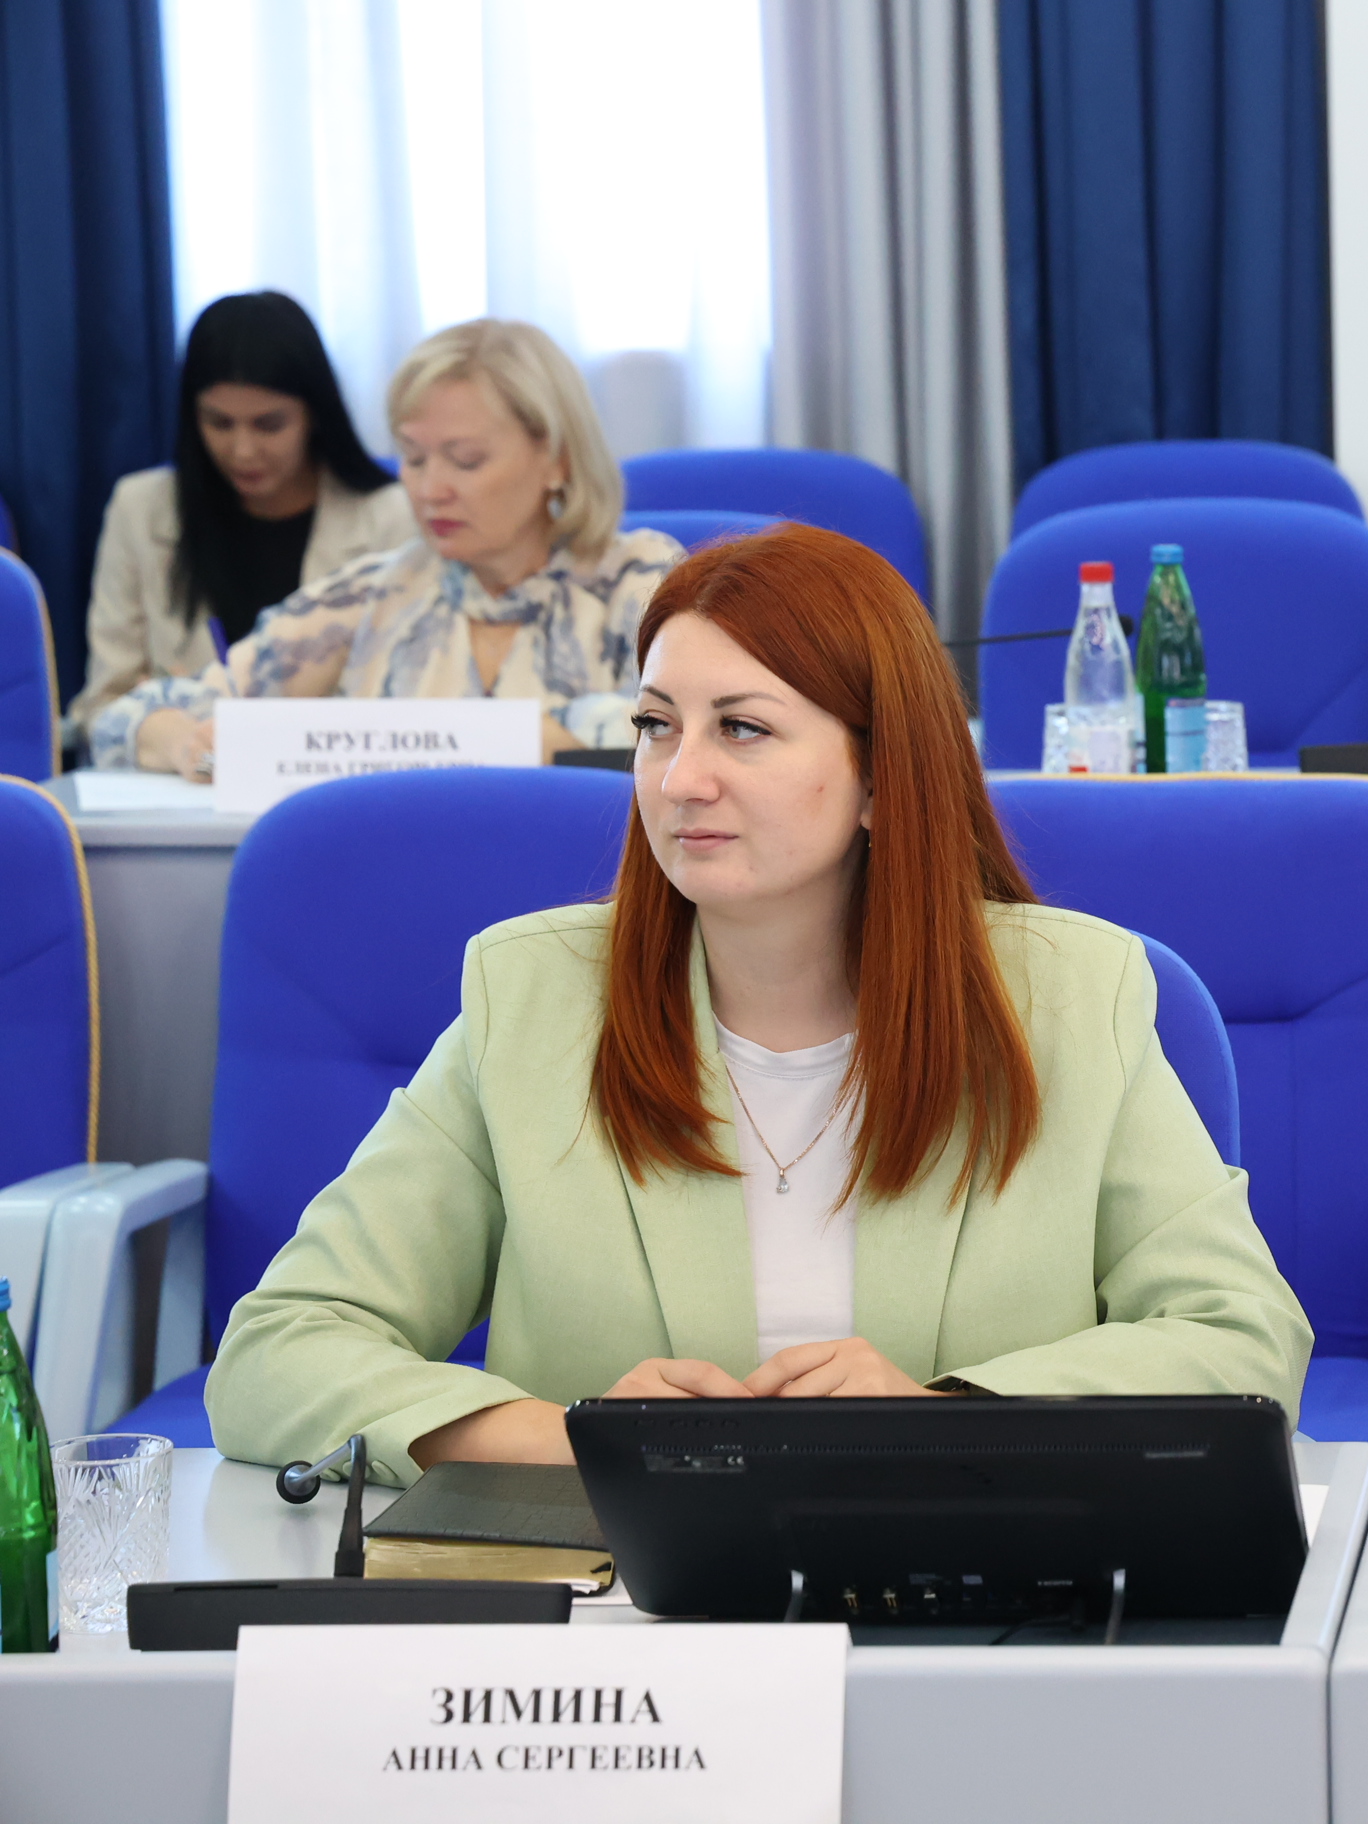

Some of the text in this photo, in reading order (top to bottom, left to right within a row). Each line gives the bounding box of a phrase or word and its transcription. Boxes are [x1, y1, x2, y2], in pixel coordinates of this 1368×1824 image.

[304, 730, 459, 752] КРУГЛОВА
[429, 1686, 663, 1725] ЗИМИНА
[383, 1745, 707, 1772] АННА СЕРГЕЕВНА
